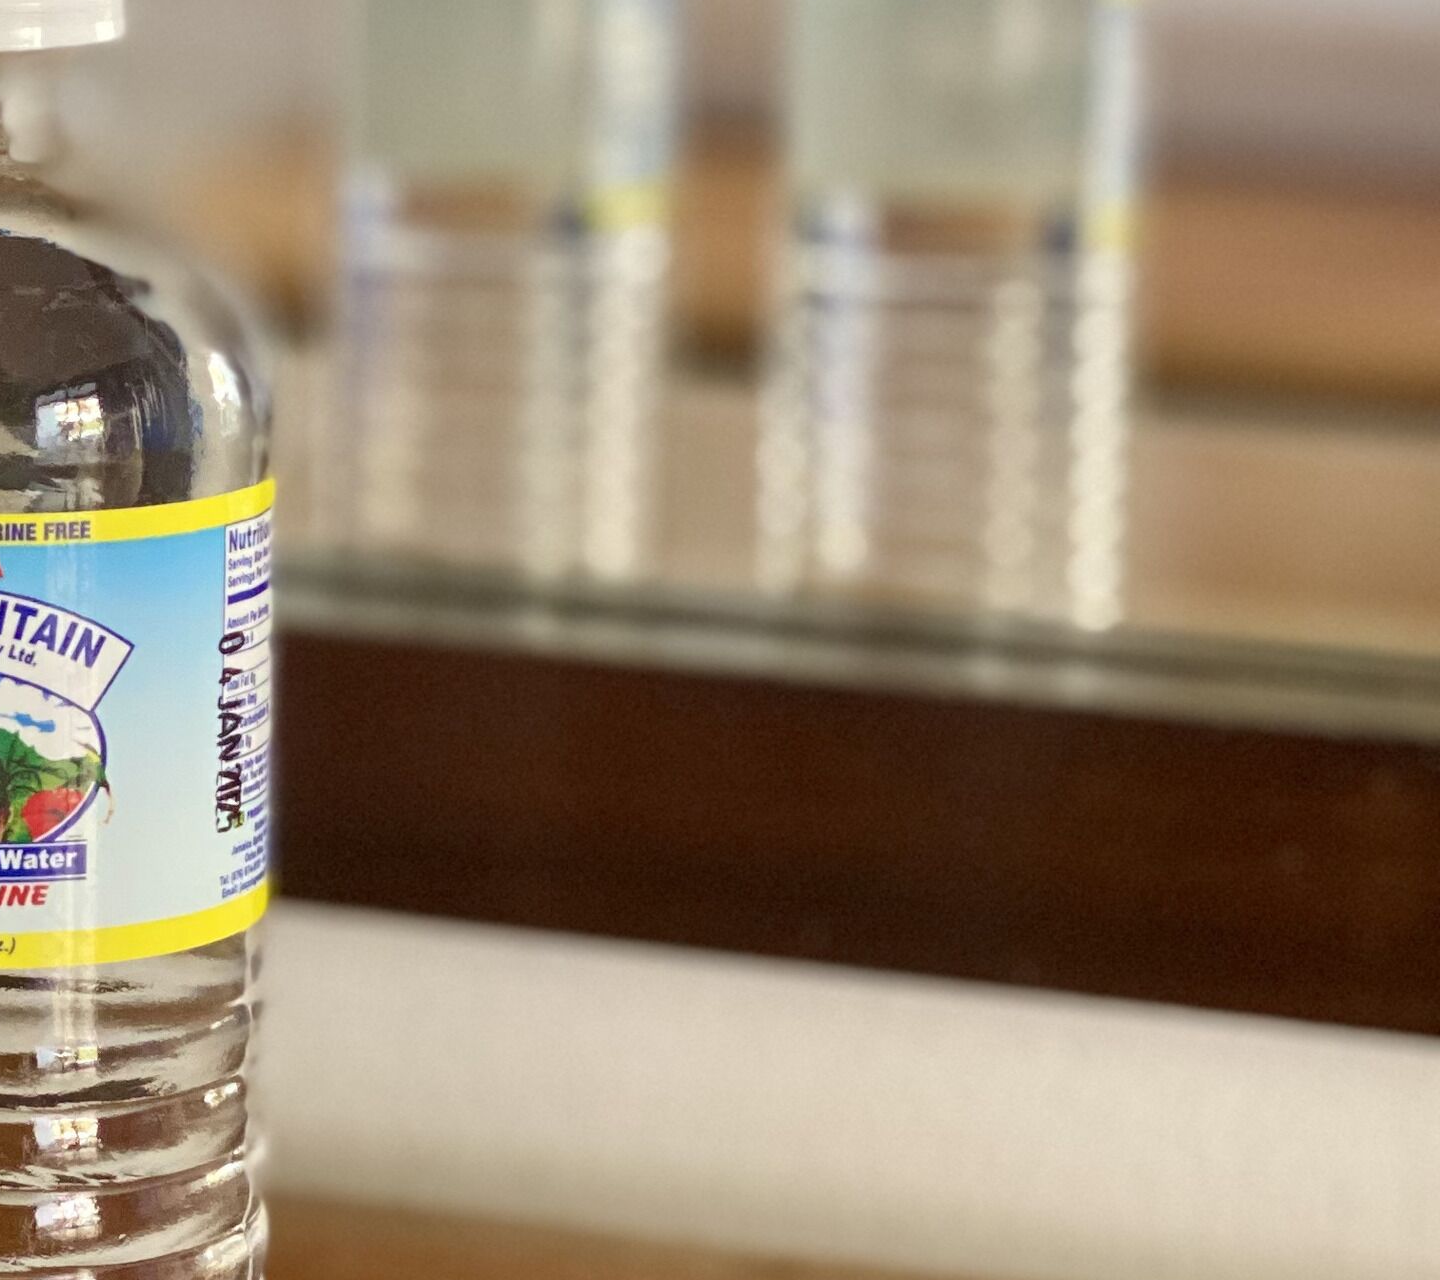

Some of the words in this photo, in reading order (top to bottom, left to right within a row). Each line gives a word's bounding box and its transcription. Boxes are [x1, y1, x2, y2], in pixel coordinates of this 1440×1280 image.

[44, 521, 91, 541] FREE
[8, 644, 37, 666] Ltd.
[217, 696, 243, 761] JAN
